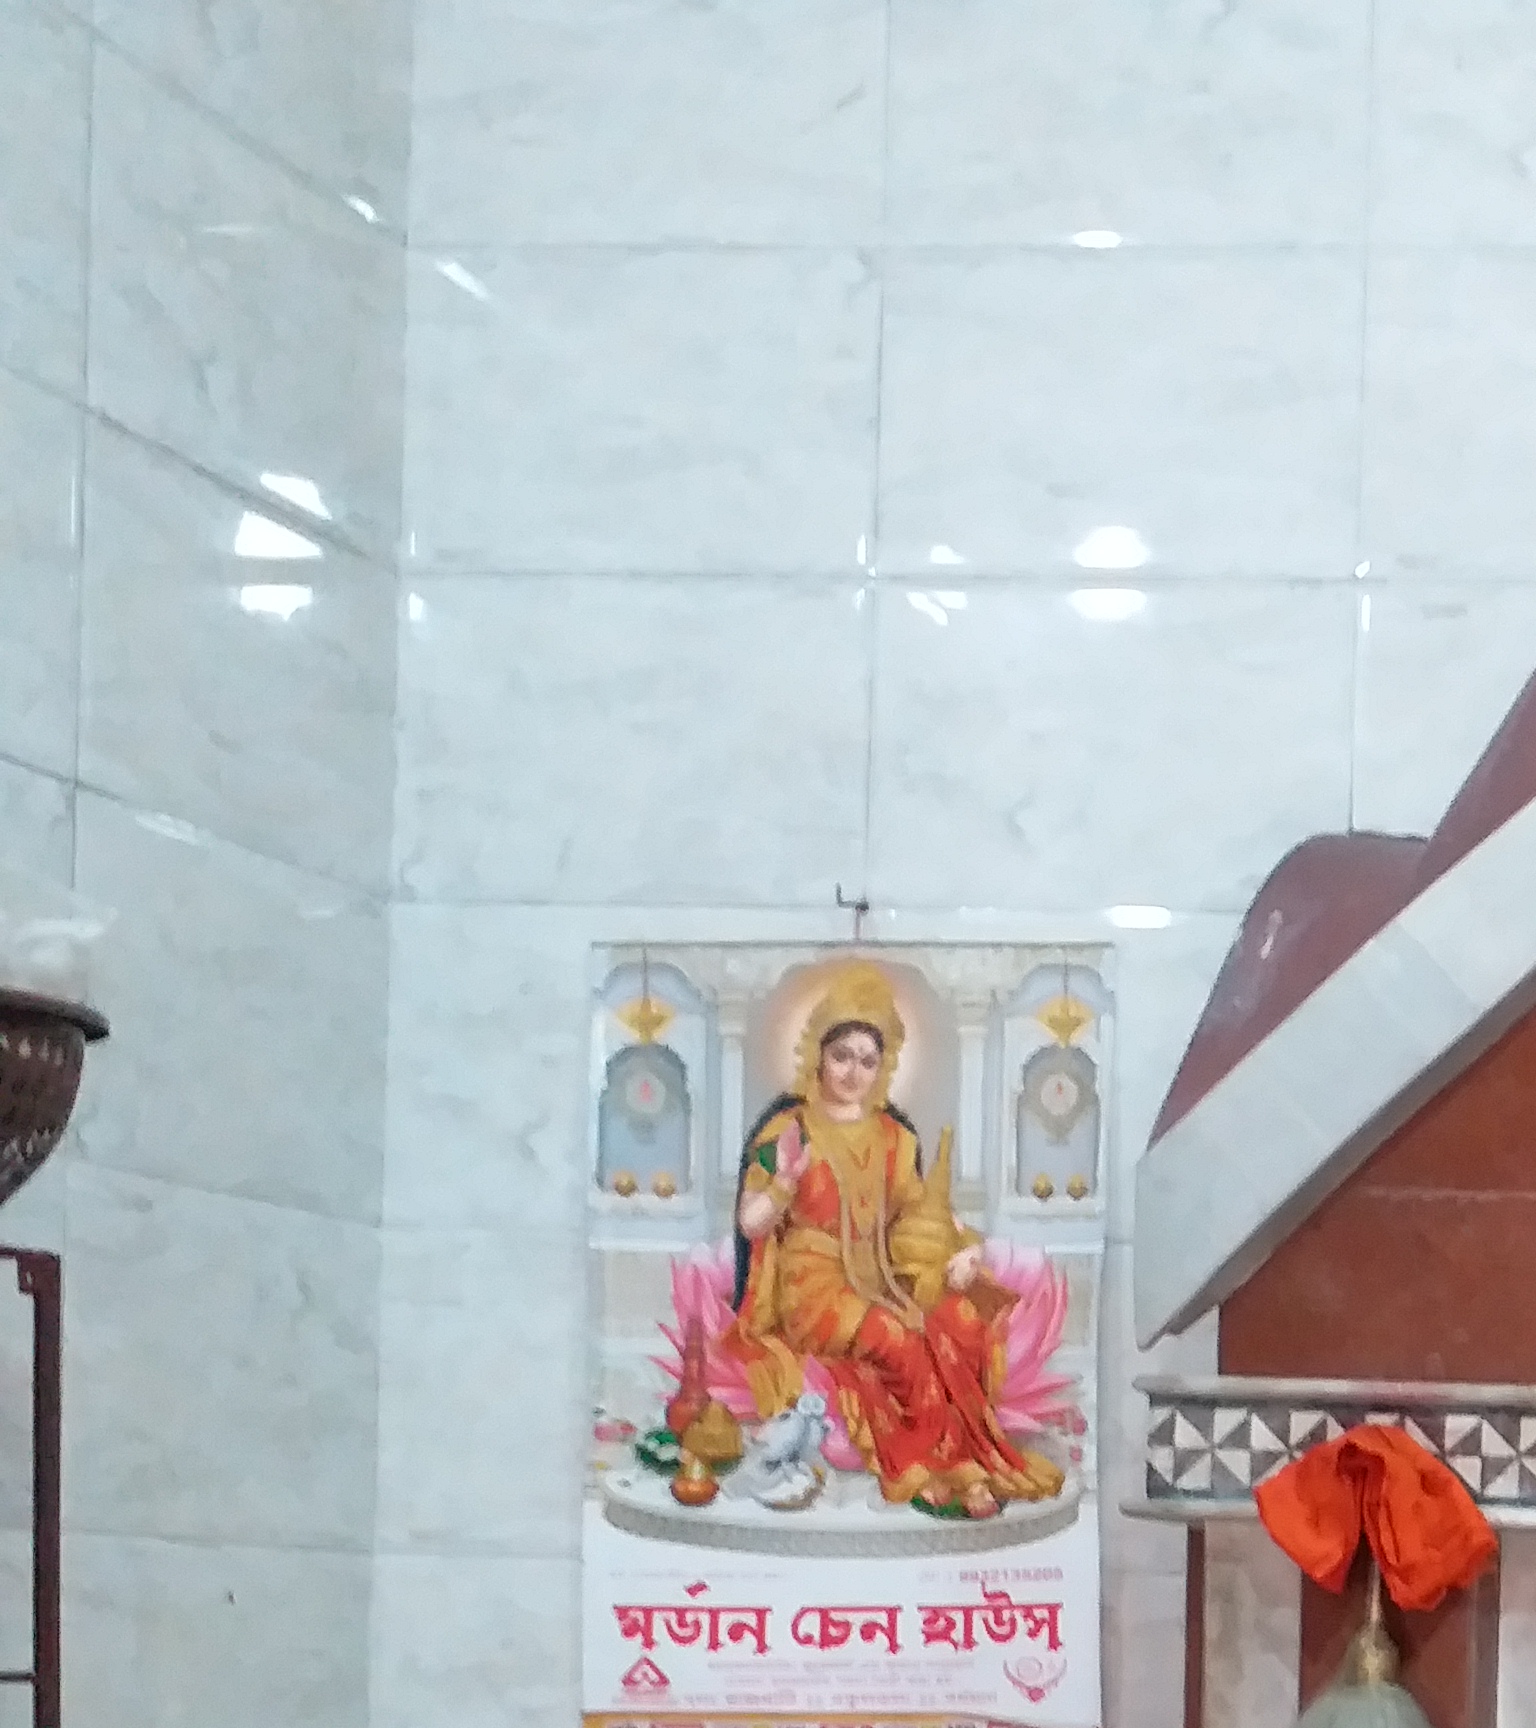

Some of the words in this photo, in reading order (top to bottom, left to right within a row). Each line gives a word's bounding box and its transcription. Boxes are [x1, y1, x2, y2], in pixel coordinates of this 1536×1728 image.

[613, 1582, 772, 1656] মর্ডান
[791, 1606, 903, 1656] চেন
[918, 1583, 1063, 1654] হাউস
